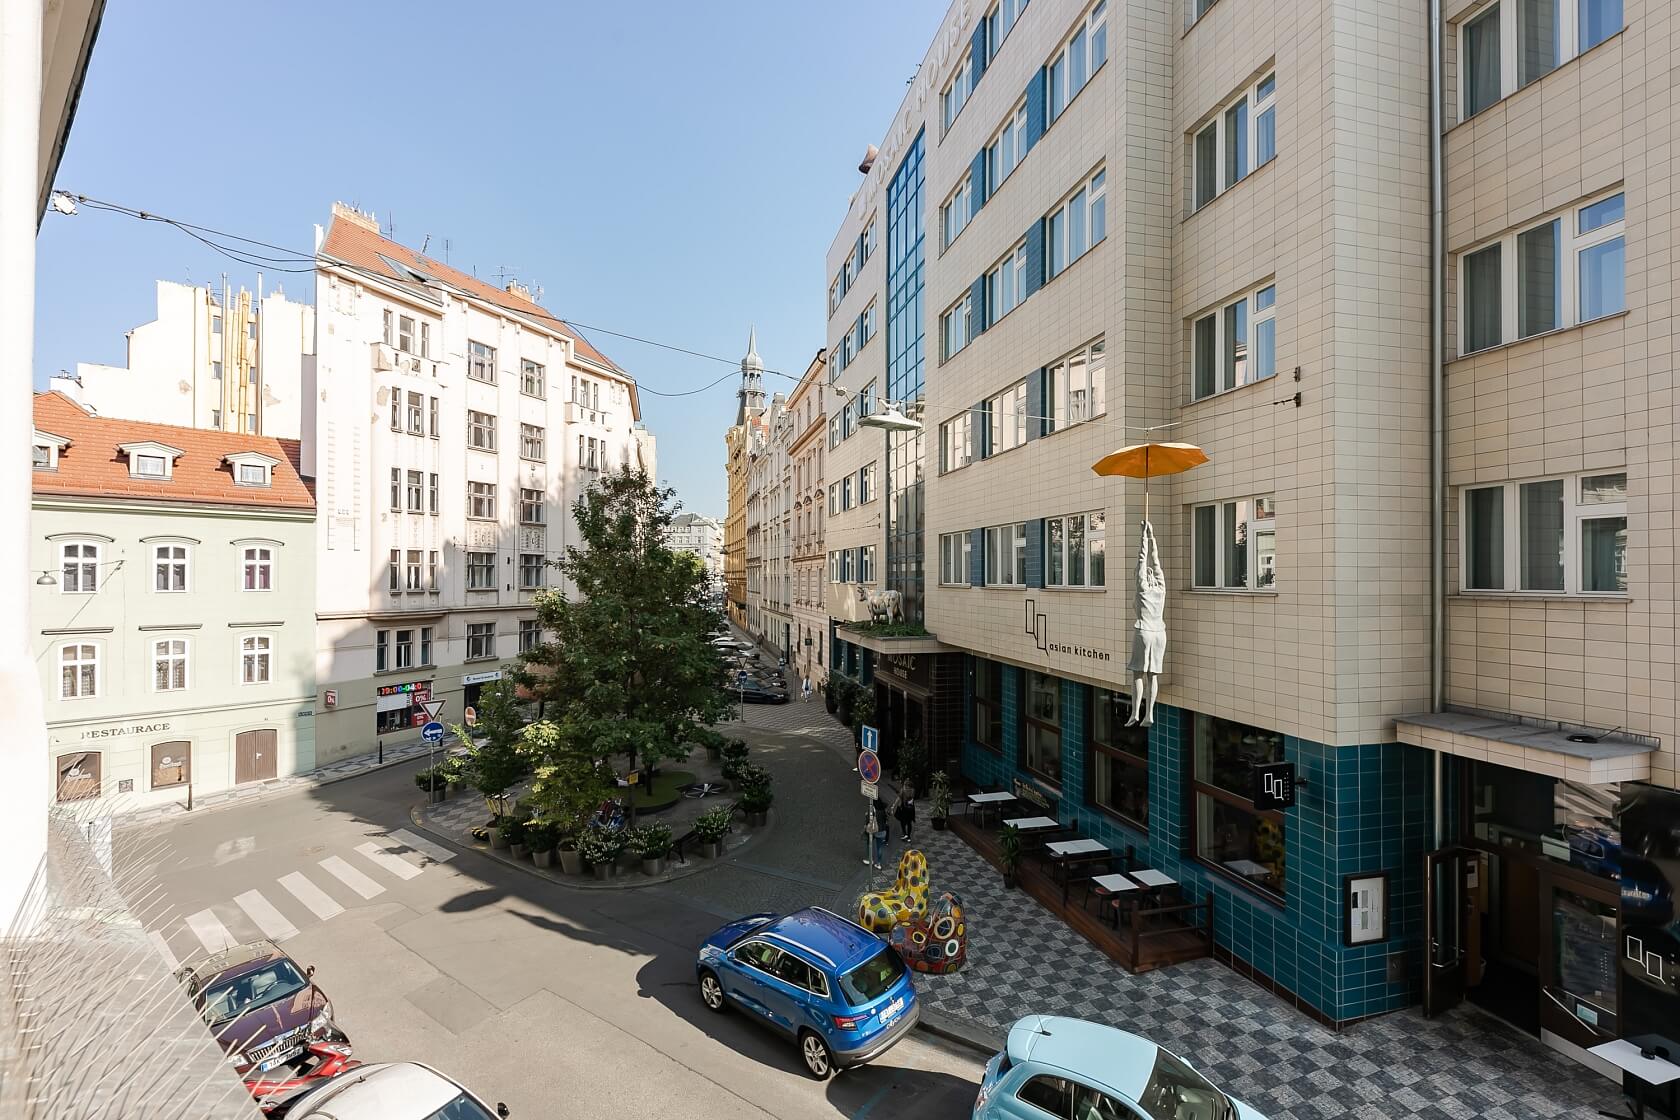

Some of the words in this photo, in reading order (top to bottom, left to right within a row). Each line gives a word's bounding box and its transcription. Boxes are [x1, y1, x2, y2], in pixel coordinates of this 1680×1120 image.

[916, 0, 971, 112] HOUSE
[1050, 643, 1071, 655] asian
[1074, 646, 1110, 661] kitchen
[81, 723, 170, 739] RESTAURACE
